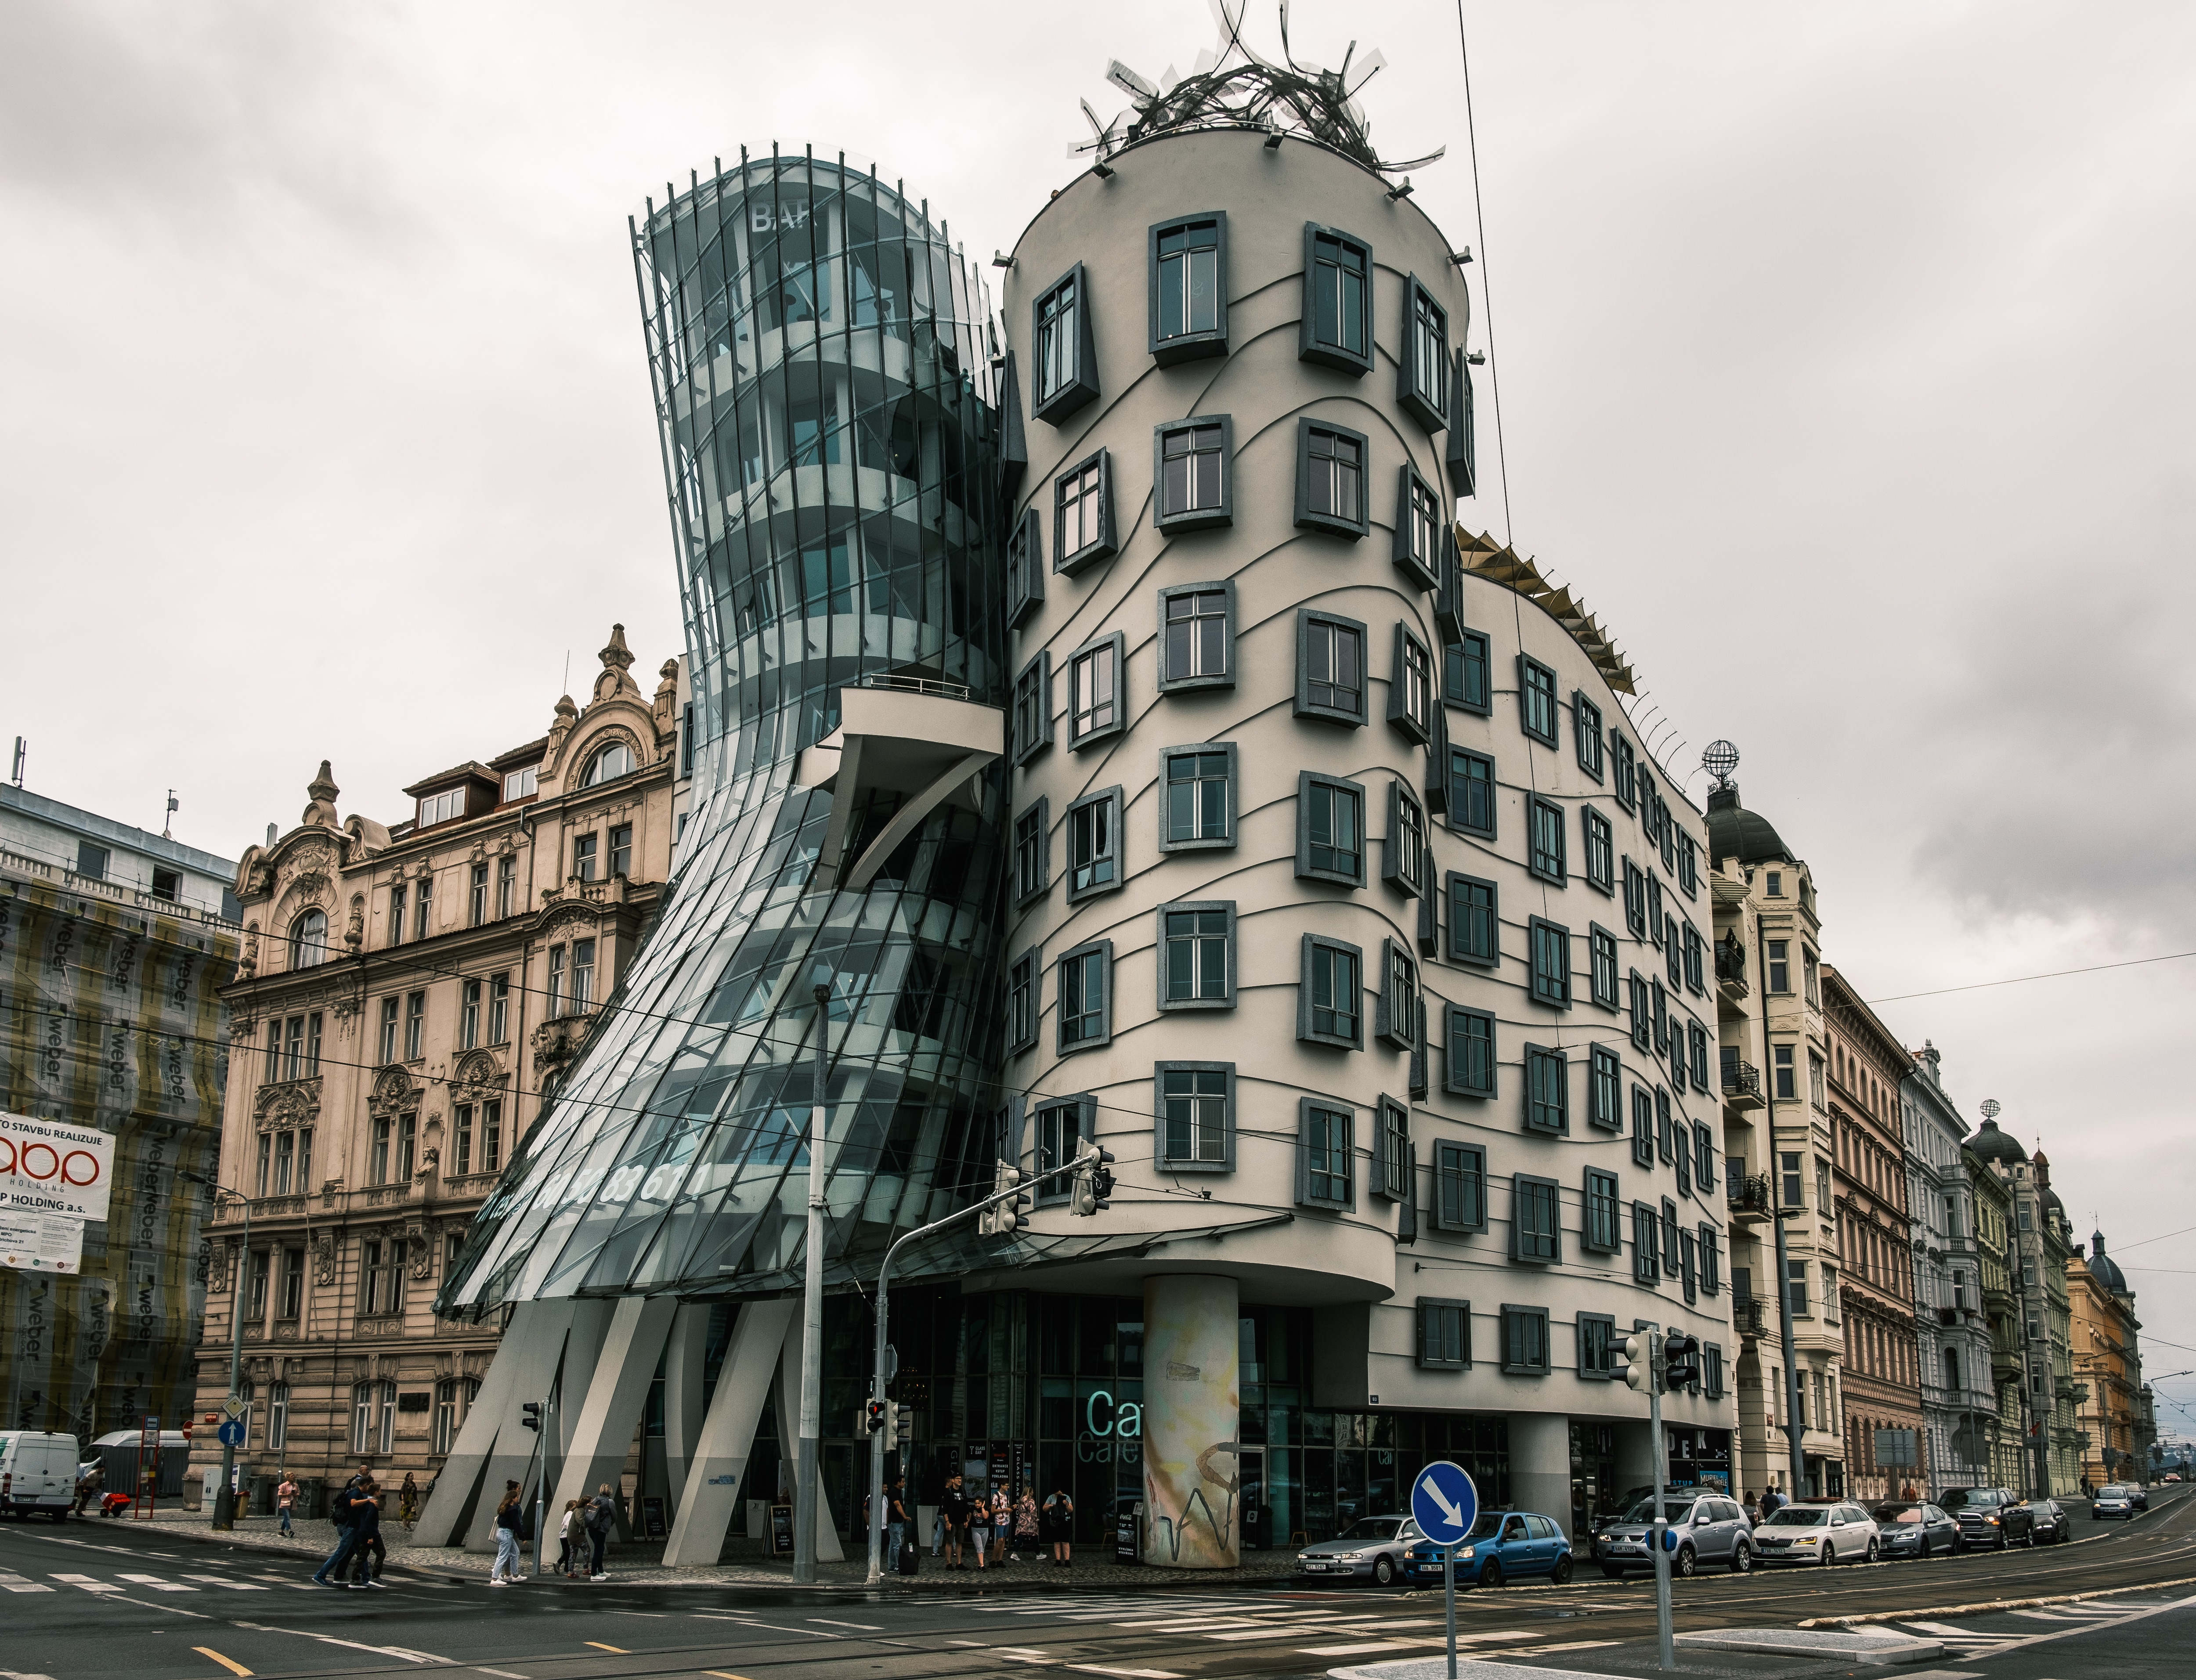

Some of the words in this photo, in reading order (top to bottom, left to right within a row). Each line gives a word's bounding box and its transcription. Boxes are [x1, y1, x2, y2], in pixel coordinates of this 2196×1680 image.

[752, 199, 818, 233] BAR
[52, 917, 77, 977] weber
[114, 934, 139, 994] weber
[174, 953, 196, 1011] weber
[47, 1018, 66, 1082] weber
[111, 1033, 129, 1092] weber
[169, 1049, 186, 1104] weber
[0, 1119, 9, 1128] O
[12, 1122, 51, 1136] STAVBU
[54, 1130, 102, 1146] REALIZUJE
[145, 1136, 168, 1194] weber
[11, 1194, 64, 1210] HOLDING
[67, 1204, 86, 1213] a.s.
[141, 1193, 159, 1249] weber
[196, 1243, 212, 1287] eber
[26, 1296, 46, 1361] weber
[78, 1405, 94, 1446] web
[122, 1387, 139, 1431] web
[1087, 1391, 1144, 1437] Ca
[1077, 1431, 1138, 1463] Cae
[1701, 1474, 1718, 1485] MURIEL
